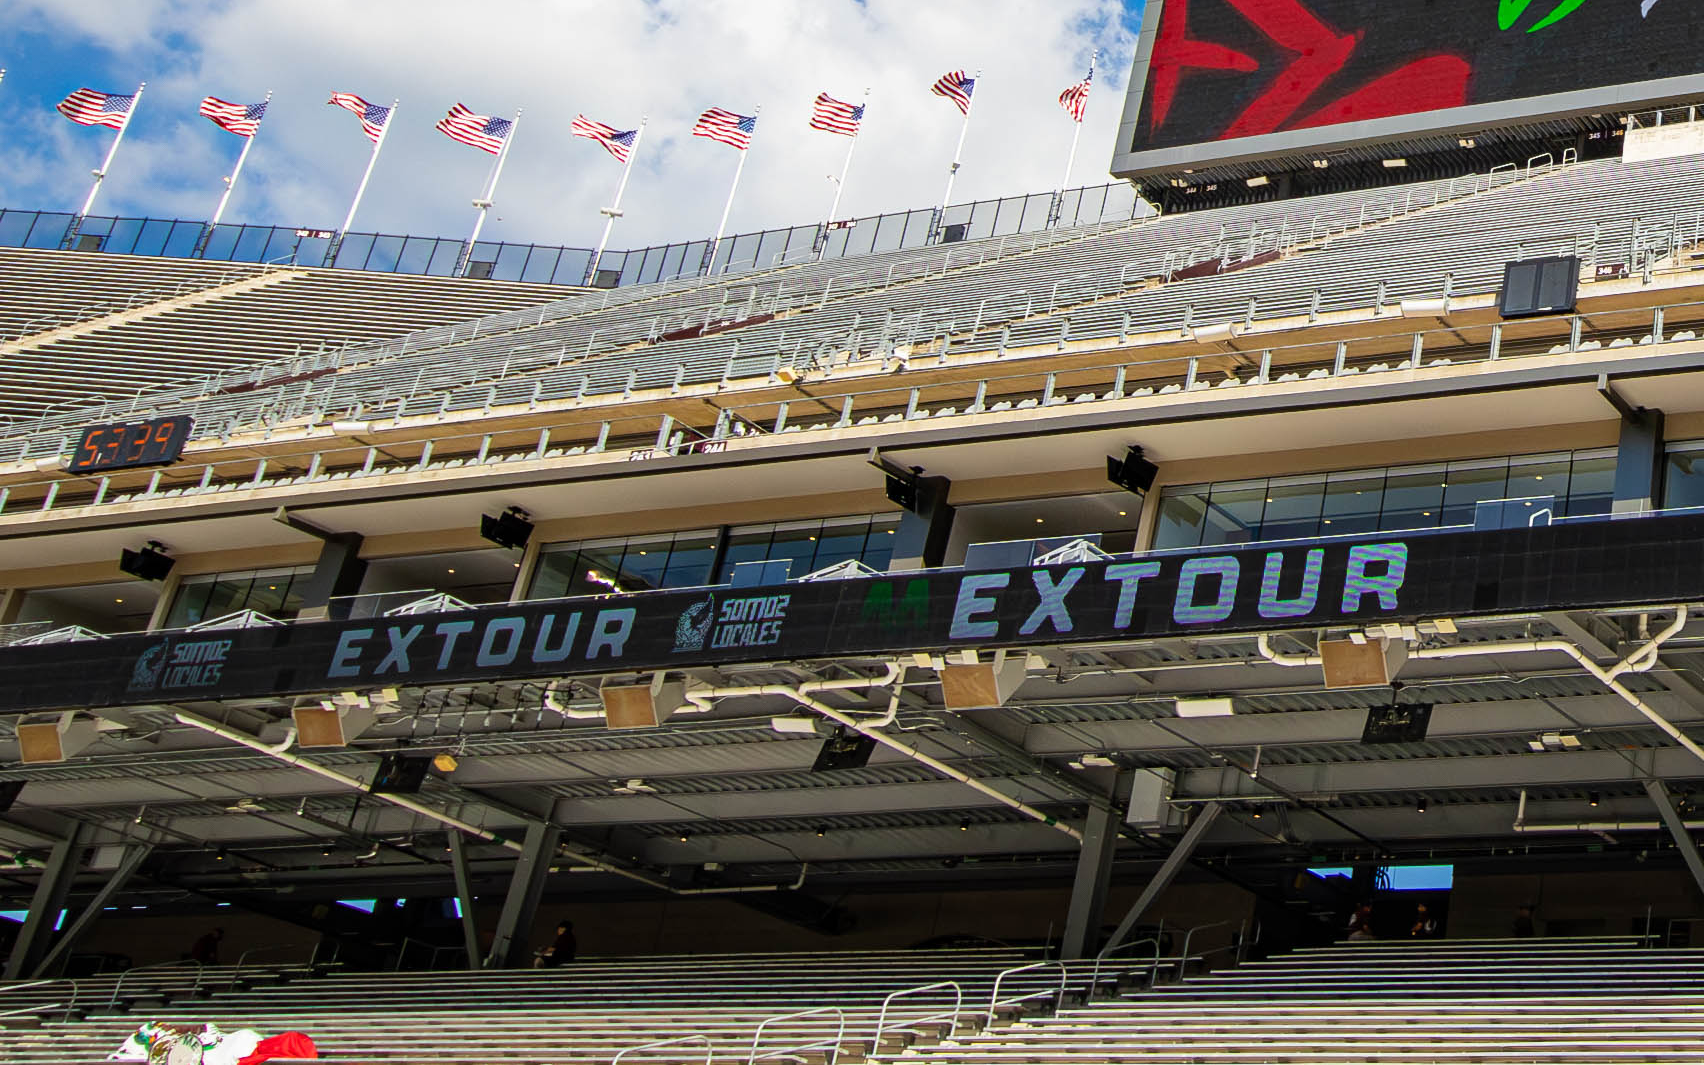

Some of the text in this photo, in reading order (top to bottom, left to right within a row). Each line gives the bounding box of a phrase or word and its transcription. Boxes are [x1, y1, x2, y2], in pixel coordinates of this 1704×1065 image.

[949, 542, 1408, 640] EXTOUR
[327, 607, 637, 679] EXTOUR
[711, 620, 783, 649] LOCALES
[161, 664, 225, 689] LOCALES
